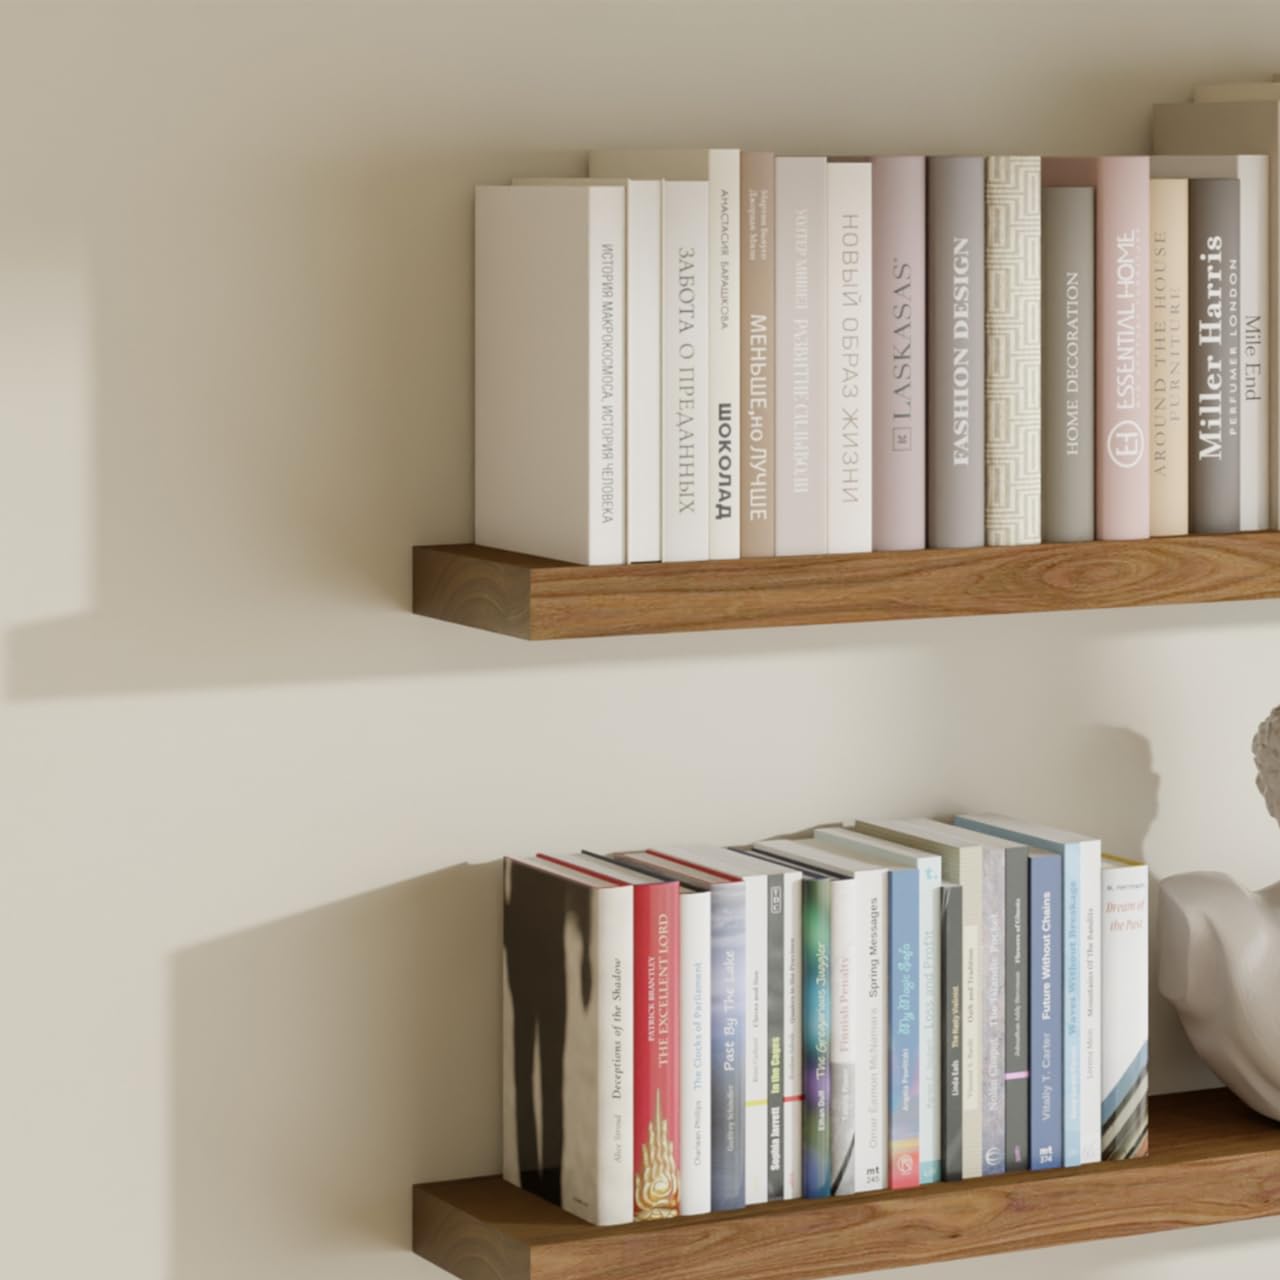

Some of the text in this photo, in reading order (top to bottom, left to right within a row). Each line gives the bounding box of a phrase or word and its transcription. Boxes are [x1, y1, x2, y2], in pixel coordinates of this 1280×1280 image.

[720, 188, 729, 329] АНАСТАСИЯ БАРАШКОВА
[1117, 231, 1135, 408] ESSENTIAL HOME
[599, 244, 614, 523] ИСТОРИЯ МАКРОКОСМОСА, ИСТОРИЯ ЧЕЛОВЕКА
[676, 247, 695, 513] ЗАБОТА О ПРЕДАННЫХ
[841, 214, 861, 503] НОВЫЙ ОБРАЗ ЖИЗНИ
[893, 263, 911, 418] LASKASAS
[953, 236, 968, 465] FASHION DESIGN
[1067, 272, 1079, 454] HOME DECORATION
[1155, 231, 1166, 477] AROUND THE HOUSE
[1170, 288, 1180, 421] FURNITURE
[1199, 236, 1222, 460] Miller Harris
[1229, 259, 1237, 435] PERFUMER LONDON
[1244, 316, 1261, 401] Mile End
[716, 403, 731, 519] ШОКОЛАД
[750, 446, 767, 520] ЛУЧШЕ
[658, 914, 668, 1068] THE EXCELLENT LORD
[724, 951, 737, 1071] Past By The Lake
[816, 943, 828, 1077] The Gregarious Juggler
[840, 957, 851, 1052] Finnish Penalty
[869, 898, 880, 997] Spring Messages
[898, 944, 914, 1034] My Magic Sofa
[1041, 891, 1050, 1019] Future Without Chains
[612, 957, 624, 1099] Deceptions of the Shadow
[694, 1071, 703, 1090] The
[771, 1036, 781, 1093] In the Cages
[1041, 1032, 1050, 1067] Carter
[1041, 1072, 1050, 1081] T.
[771, 1107, 781, 1170] Sophia Jarrett
[866, 1166, 879, 1175] mt
